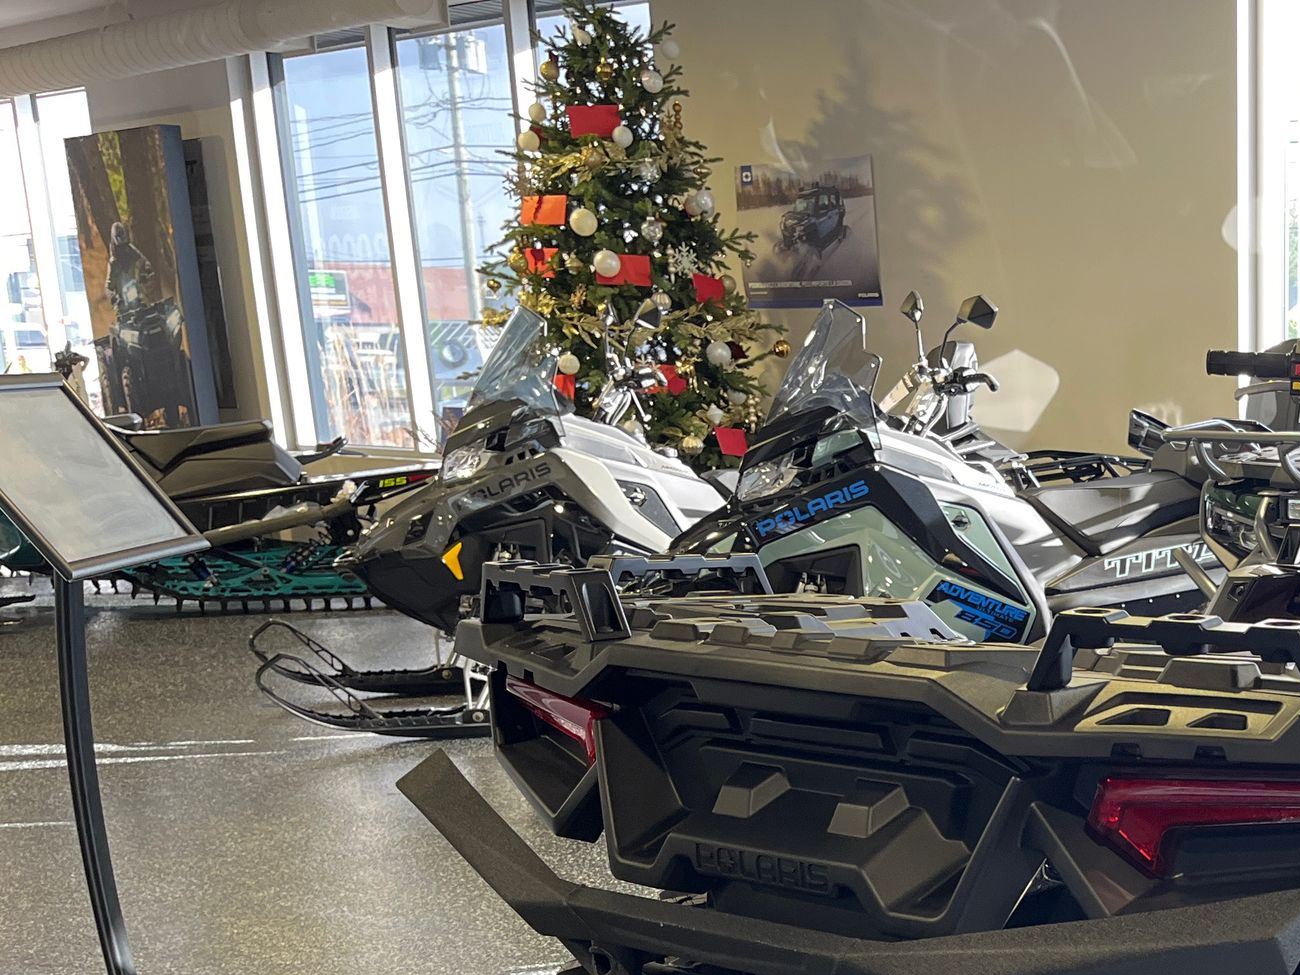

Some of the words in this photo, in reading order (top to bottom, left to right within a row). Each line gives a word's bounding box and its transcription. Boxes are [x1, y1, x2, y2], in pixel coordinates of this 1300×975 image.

[378, 476, 408, 488] 155
[464, 462, 552, 500] OLARIS
[756, 479, 870, 538] POLARIS
[936, 581, 1029, 623] ADVENTURE
[952, 608, 1019, 640] 850
[694, 842, 834, 894] POLARIS
